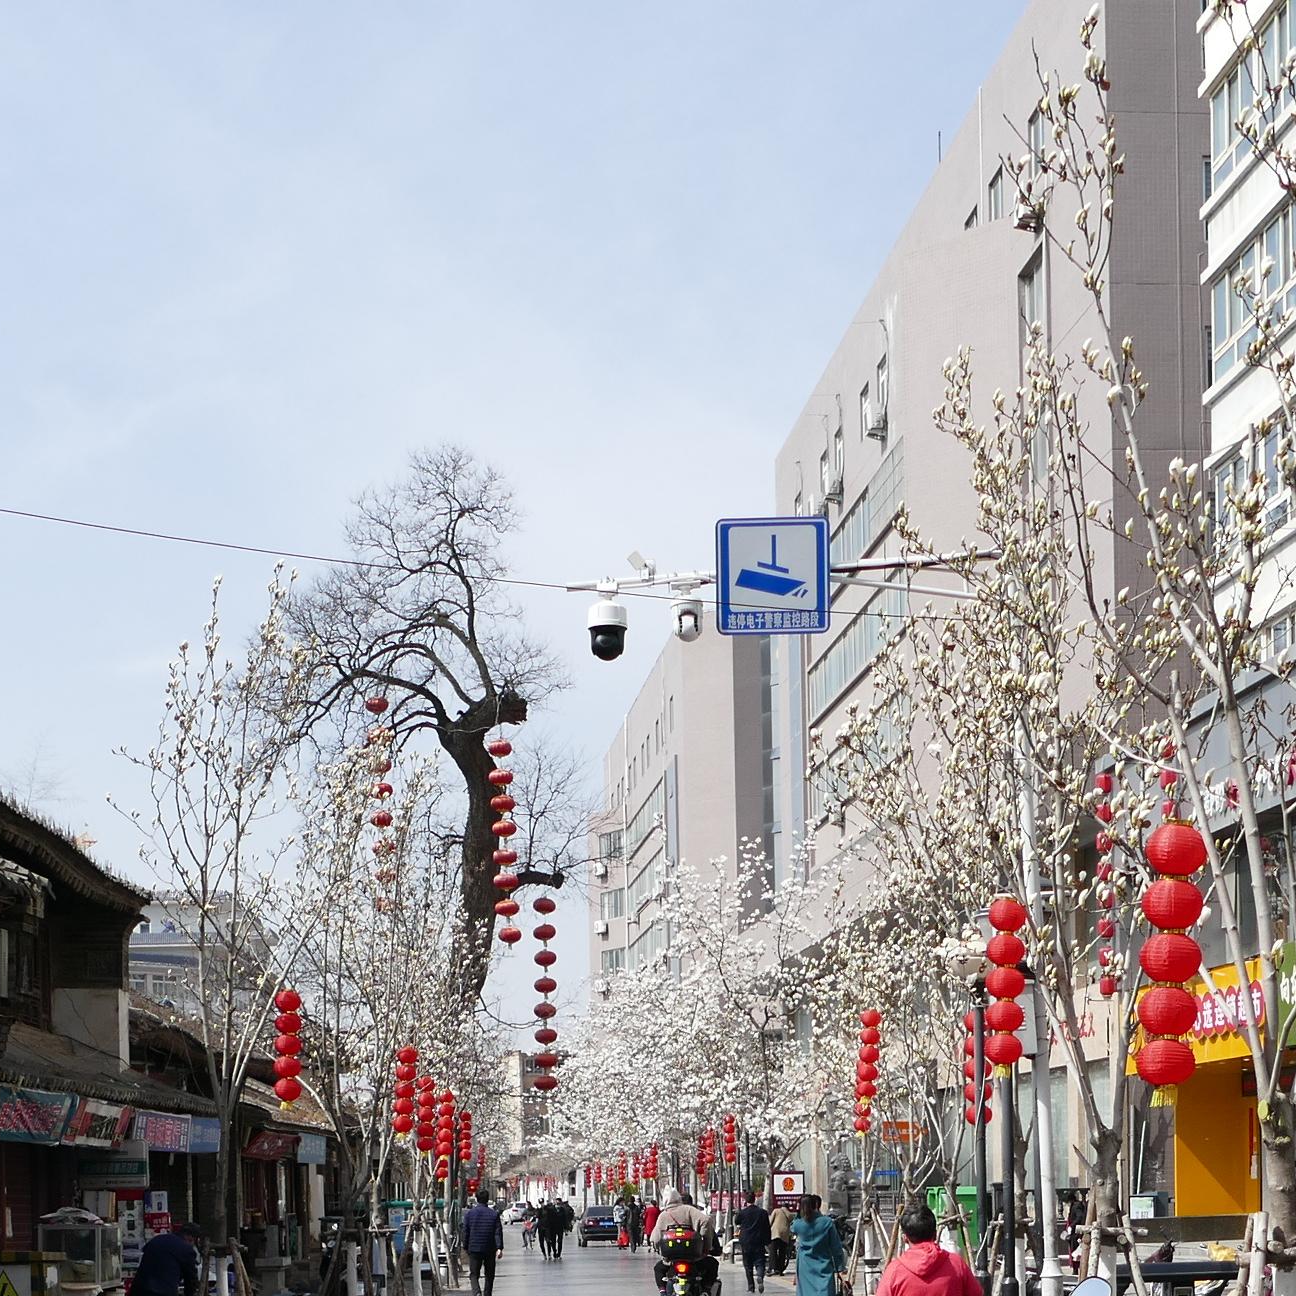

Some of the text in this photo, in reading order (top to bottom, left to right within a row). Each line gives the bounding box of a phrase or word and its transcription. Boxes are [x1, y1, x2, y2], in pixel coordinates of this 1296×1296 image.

[728, 612, 819, 629] 违停电子警察监控路段
